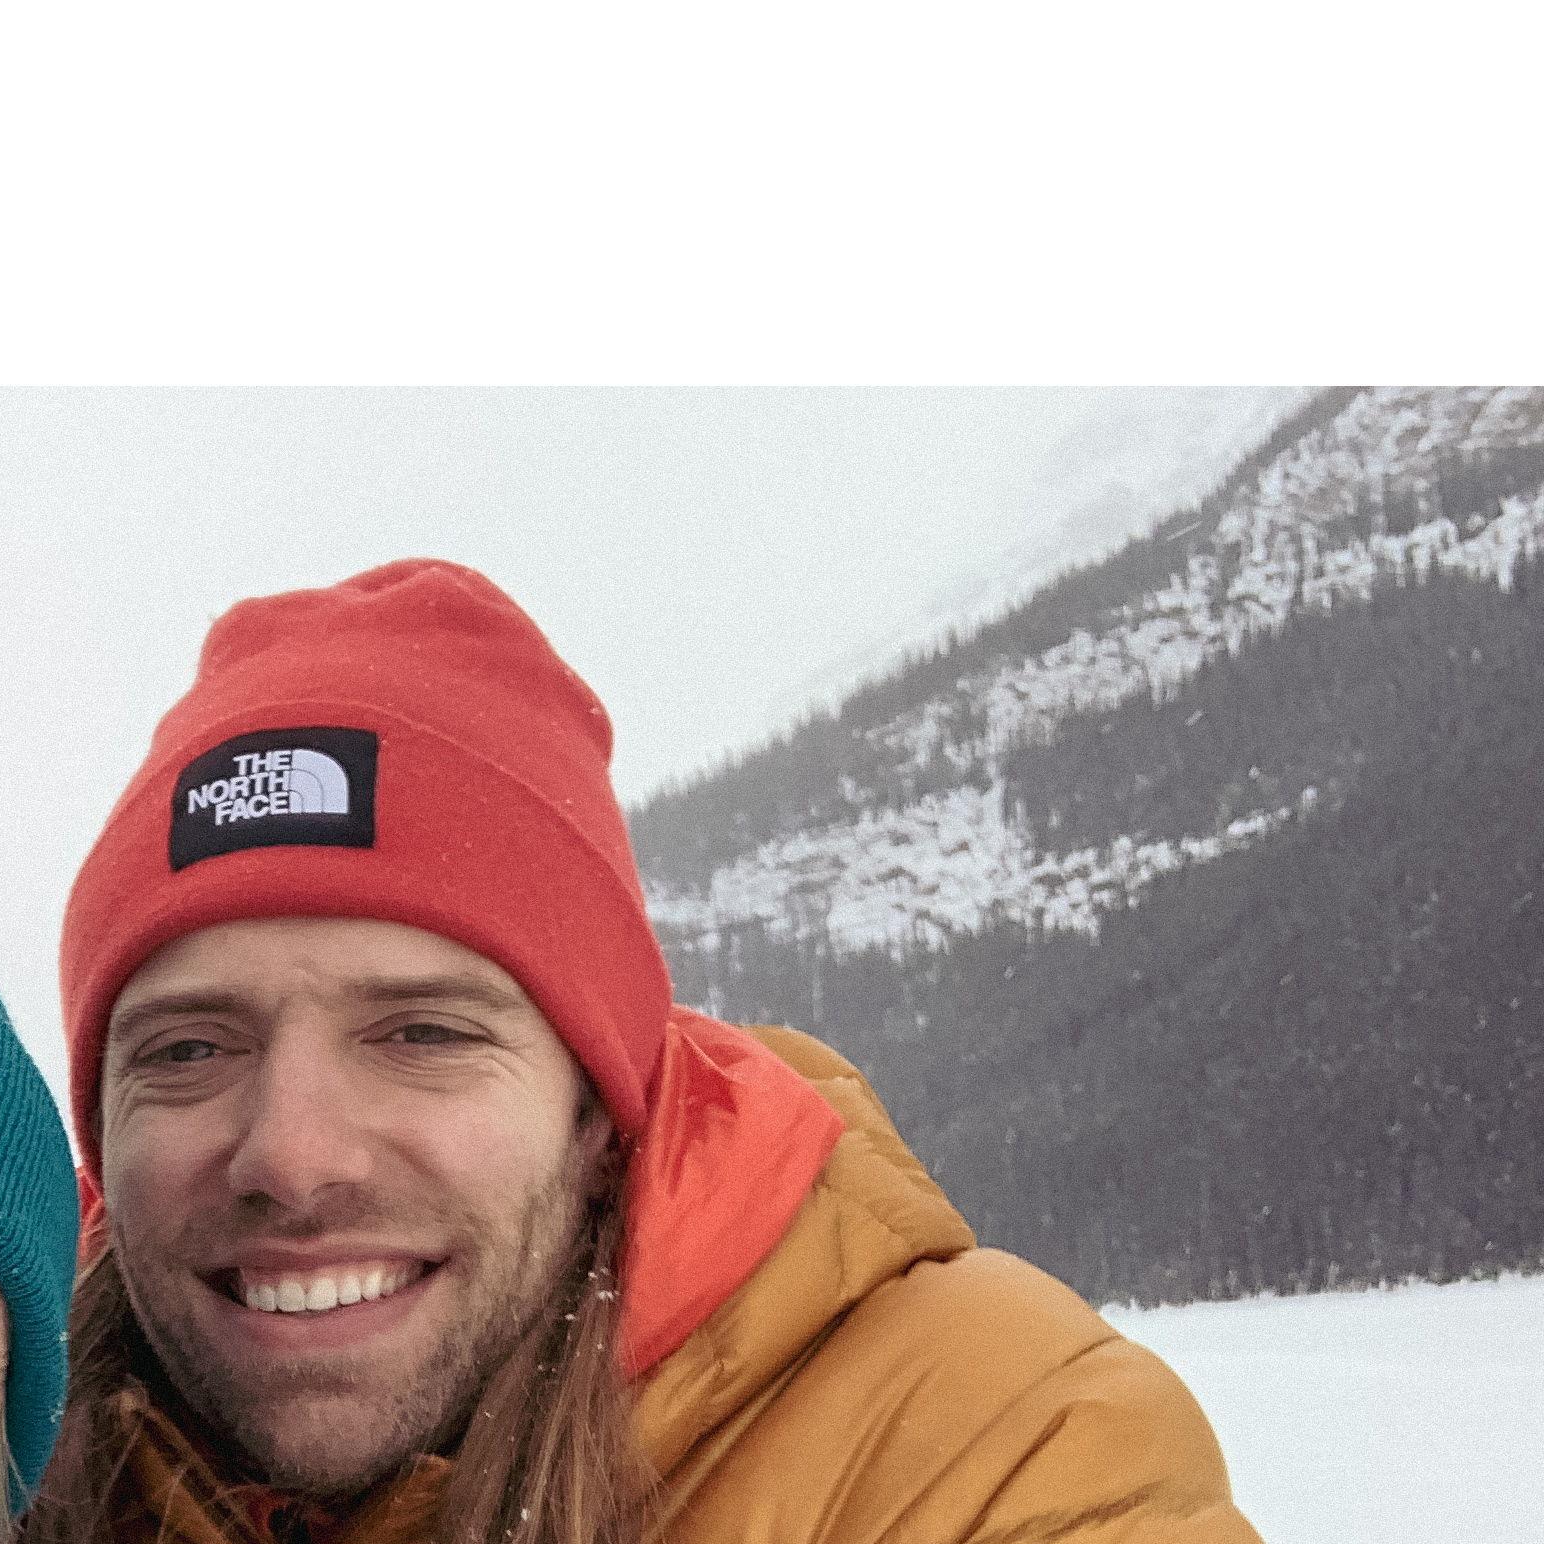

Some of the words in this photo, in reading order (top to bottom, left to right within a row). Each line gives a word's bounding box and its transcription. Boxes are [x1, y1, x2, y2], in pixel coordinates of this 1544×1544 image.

[233, 750, 292, 776] THE
[187, 769, 290, 813] NORTH
[214, 791, 289, 826] FACE
